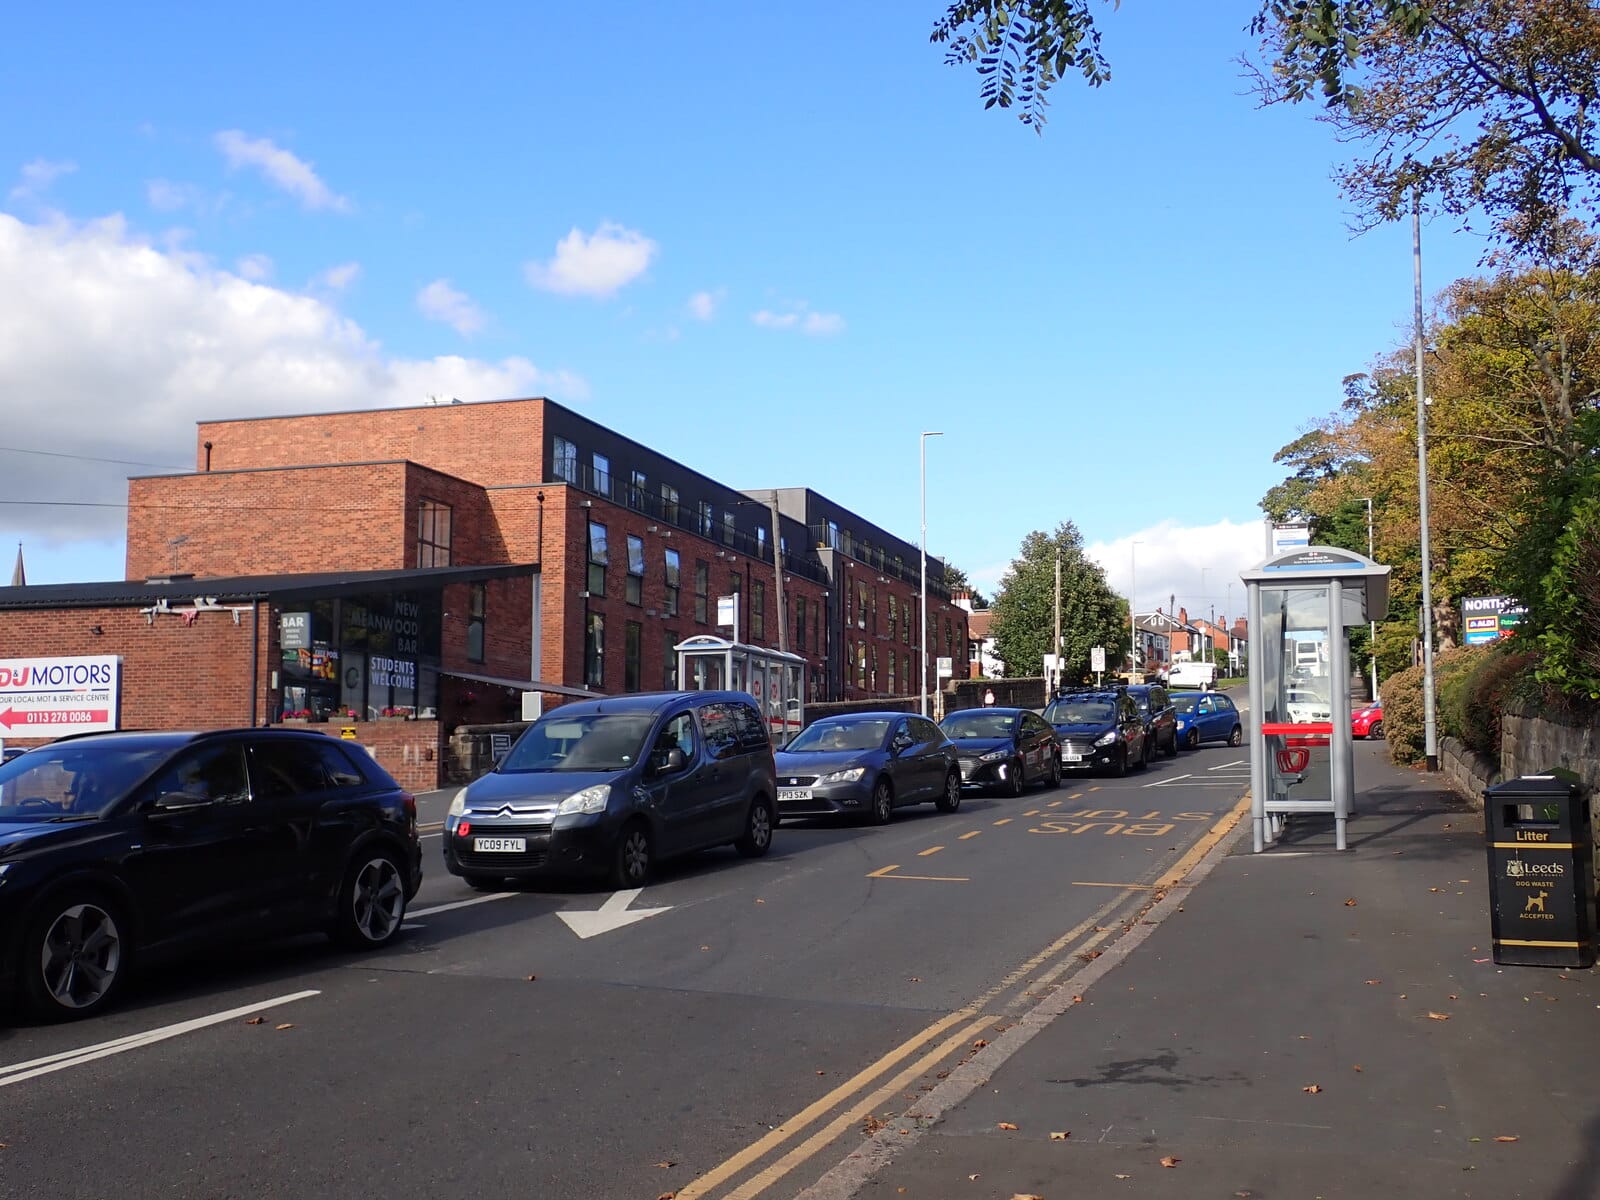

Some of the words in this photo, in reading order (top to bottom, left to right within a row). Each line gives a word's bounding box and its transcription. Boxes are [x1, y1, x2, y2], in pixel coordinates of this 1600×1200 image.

[394, 601, 418, 618] NEW
[282, 617, 304, 627] BAR
[351, 609, 417, 635] MEANWOOD
[398, 638, 417, 654] BAR
[371, 657, 415, 675] STUDENTS
[0, 667, 30, 687] D&J
[32, 664, 111, 685] MOTORS
[371, 672, 416, 690] WELCOME
[0, 696, 13, 704] OUR
[14, 695, 35, 703] LOCAL
[59, 694, 84, 702] SERVICE
[86, 693, 109, 702] CENTRE
[27, 712, 49, 723] 0113
[51, 711, 68, 722] 278
[69, 711, 92, 722] 0086
[1039, 809, 1214, 821] STOP
[1028, 821, 1176, 836] BUS
[1516, 830, 1548, 841] Litter
[478, 839, 502, 850] YC09
[503, 839, 521, 850] FYL
[1525, 863, 1564, 873] Leeds
